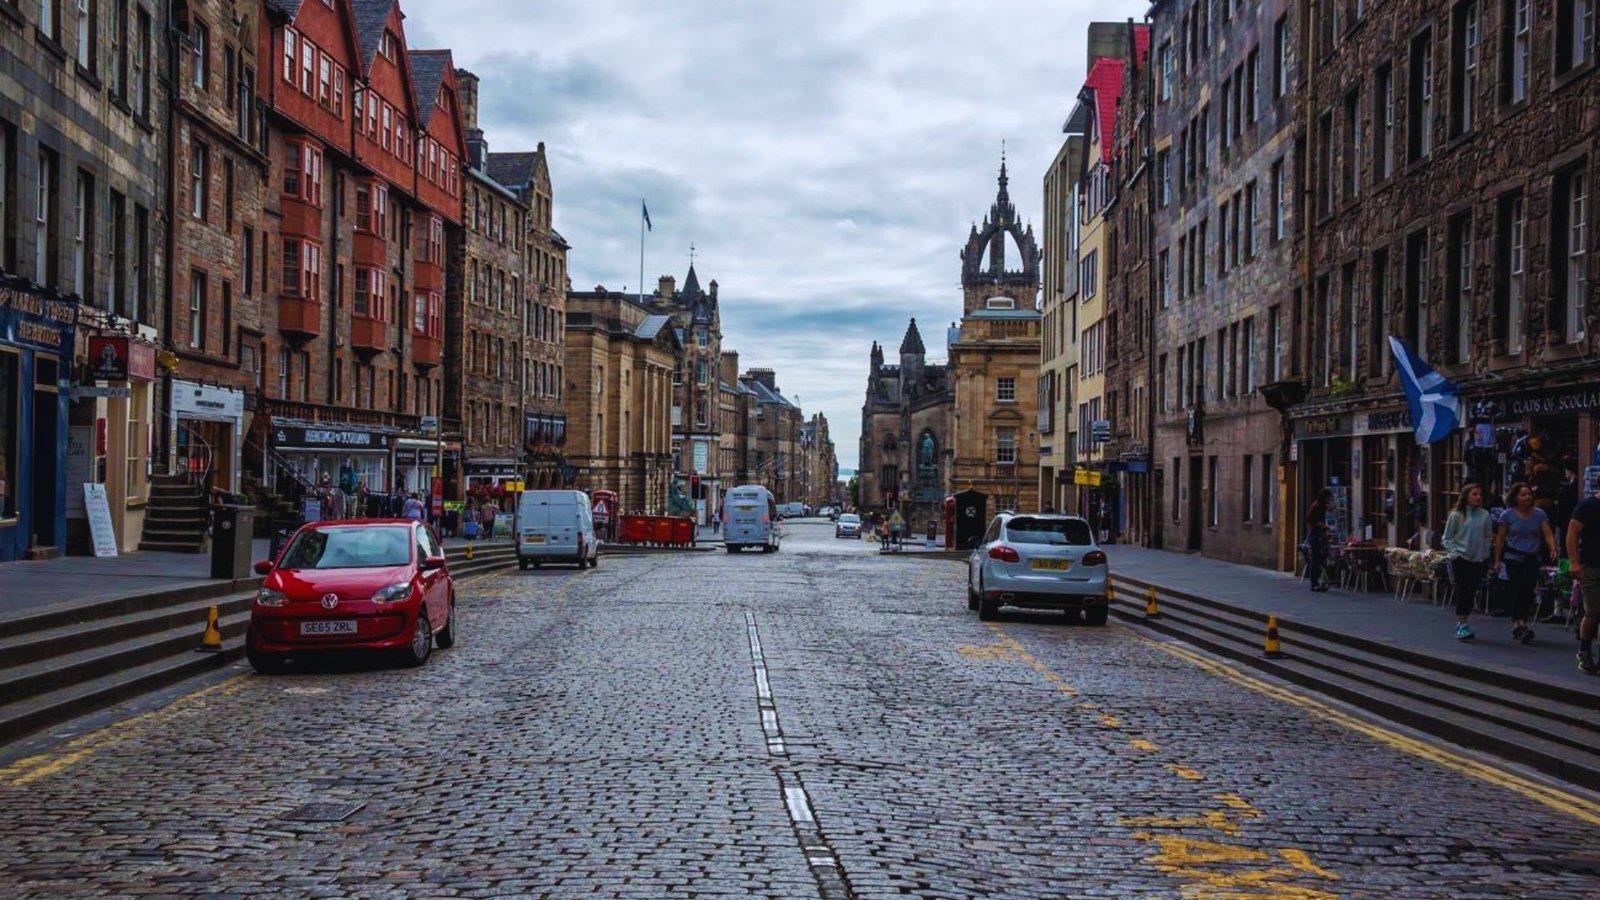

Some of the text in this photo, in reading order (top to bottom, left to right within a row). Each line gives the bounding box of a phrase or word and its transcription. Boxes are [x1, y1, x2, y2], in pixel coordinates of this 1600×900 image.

[11, 290, 43, 316] HARRIS
[1513, 398, 1541, 413] CLANS
[305, 621, 352, 631] SE65 ZRL
